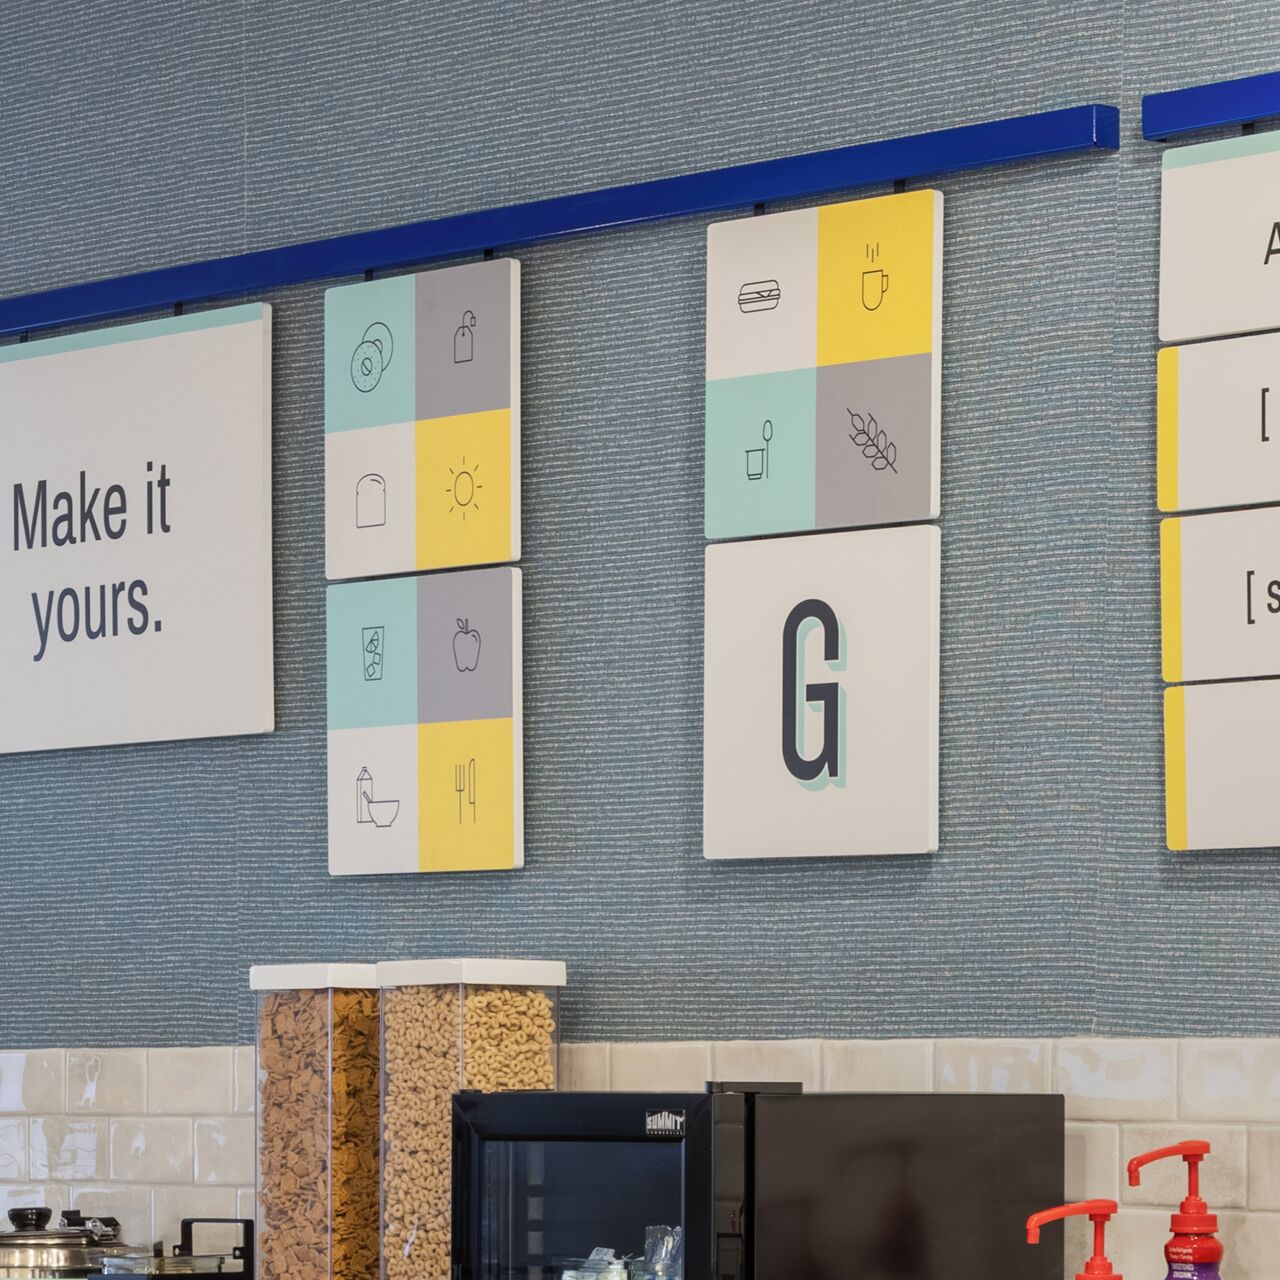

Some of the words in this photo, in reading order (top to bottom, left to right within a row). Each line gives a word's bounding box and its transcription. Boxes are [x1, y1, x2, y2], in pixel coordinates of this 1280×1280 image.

[14, 471, 127, 551] Make
[146, 461, 170, 535] it
[31, 579, 162, 662] yours.
[781, 598, 841, 781] G
[647, 1111, 685, 1130] SUMMIT
